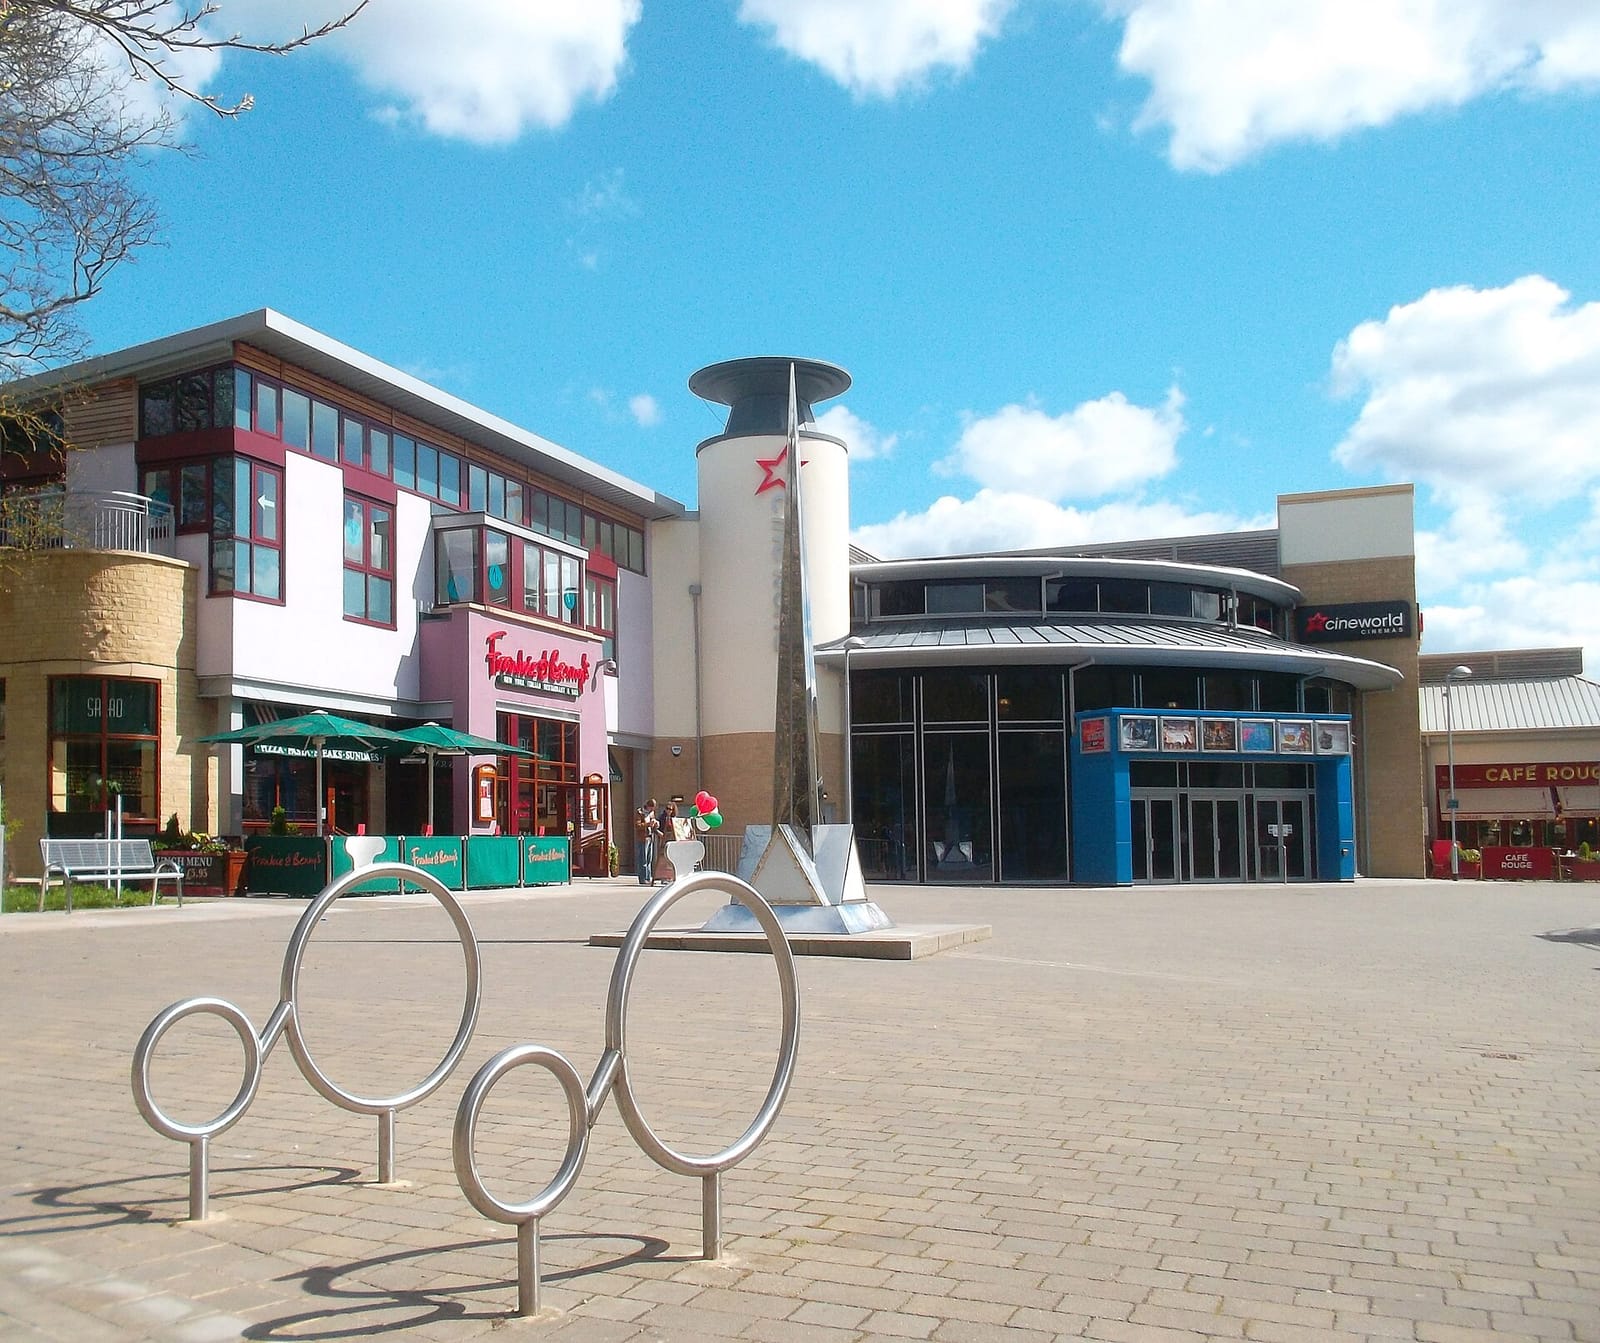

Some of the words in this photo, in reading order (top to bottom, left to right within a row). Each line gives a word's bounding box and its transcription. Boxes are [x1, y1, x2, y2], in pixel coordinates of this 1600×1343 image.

[1325, 612, 1403, 630] cineworld
[88, 697, 123, 718] SAAD
[314, 749, 343, 759] SEAKS
[1486, 765, 1537, 782] CAFÉ
[187, 857, 213, 867] MENU
[1501, 861, 1533, 869] ROUGE
